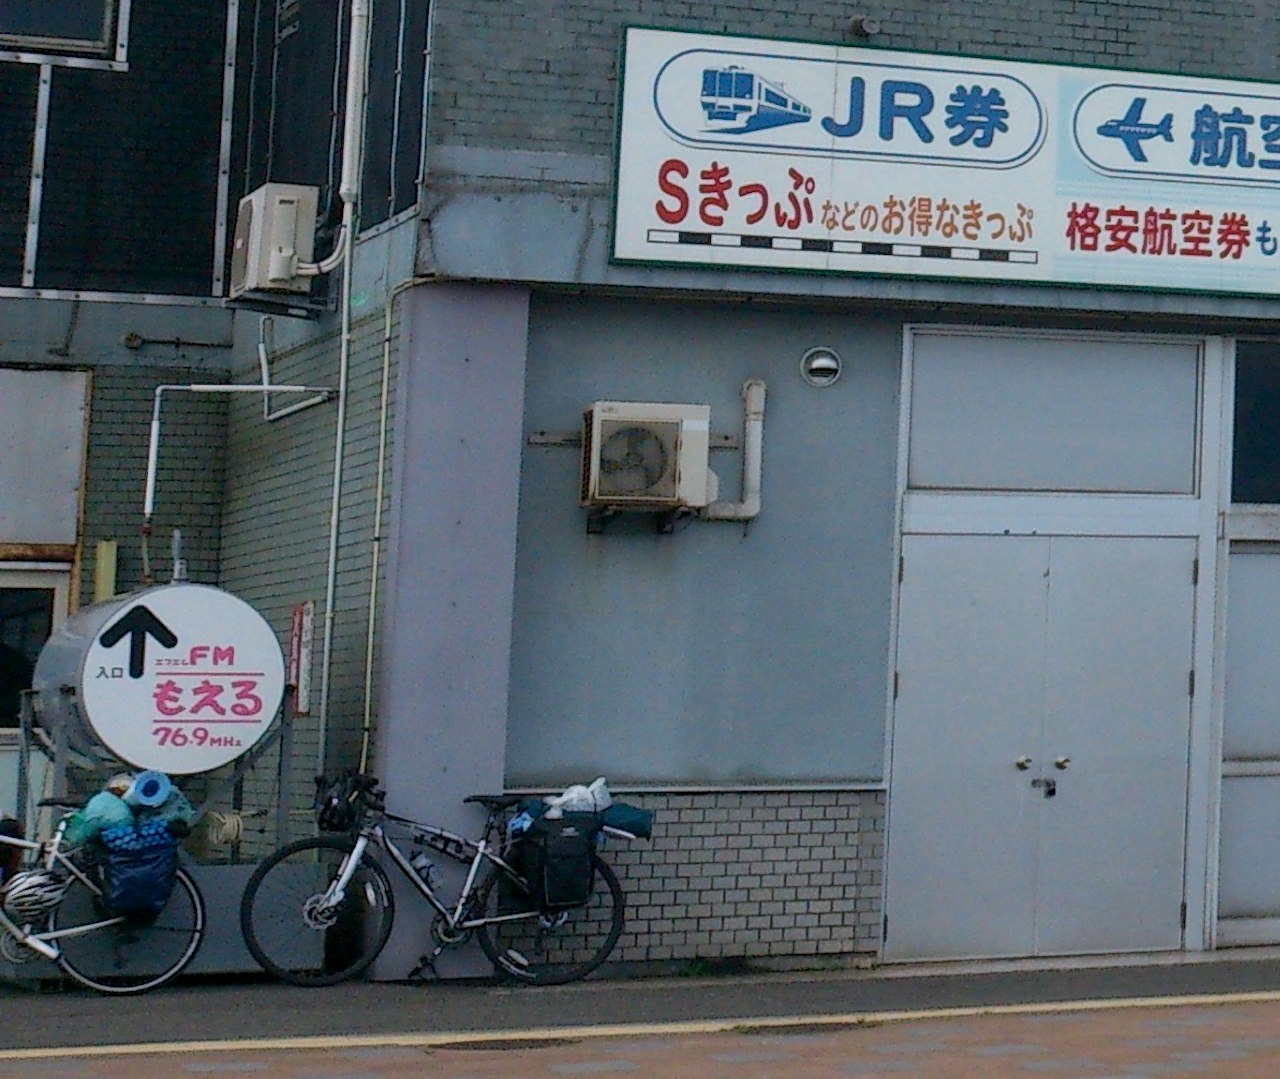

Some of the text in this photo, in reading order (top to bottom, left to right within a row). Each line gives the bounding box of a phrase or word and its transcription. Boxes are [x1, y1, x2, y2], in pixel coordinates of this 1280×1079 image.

[820, 75, 1010, 150] JR券
[189, 646, 235, 666] FM
[95, 667, 123, 679] 入口
[153, 679, 263, 717] もえる
